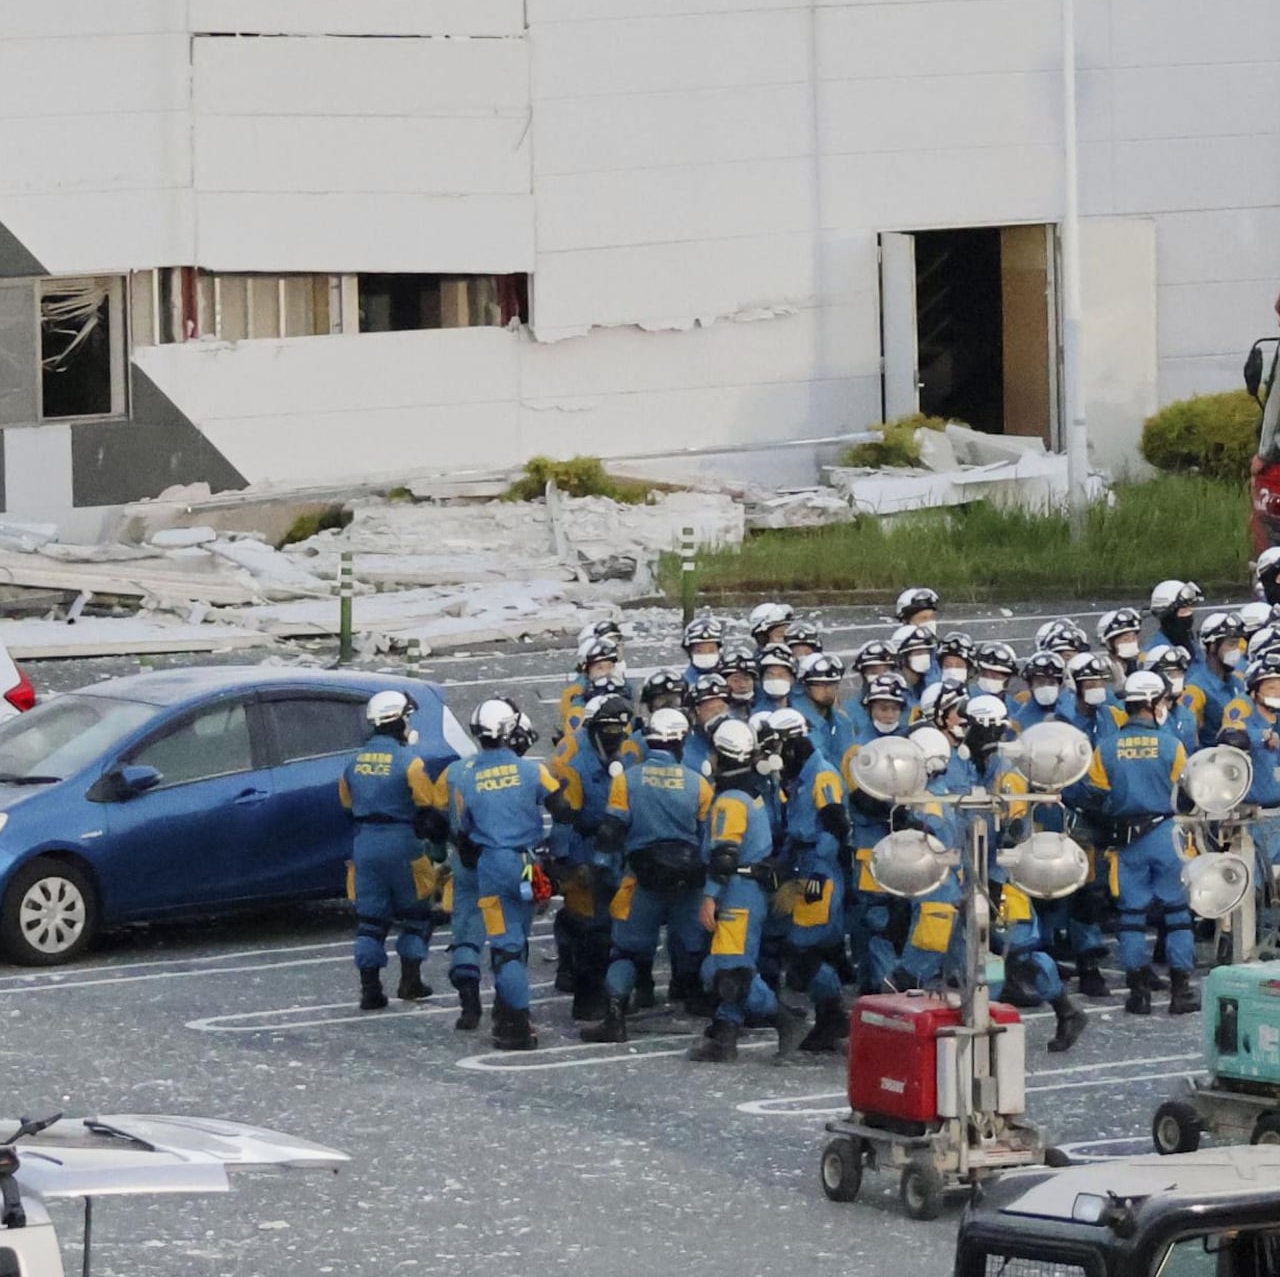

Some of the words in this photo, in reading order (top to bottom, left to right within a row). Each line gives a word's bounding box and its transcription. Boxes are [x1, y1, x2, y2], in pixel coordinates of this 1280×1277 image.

[1117, 747, 1159, 761] POLICE
[354, 763, 391, 776] POLICE
[476, 774, 521, 793] POLICE
[641, 776, 685, 790] POLICE
